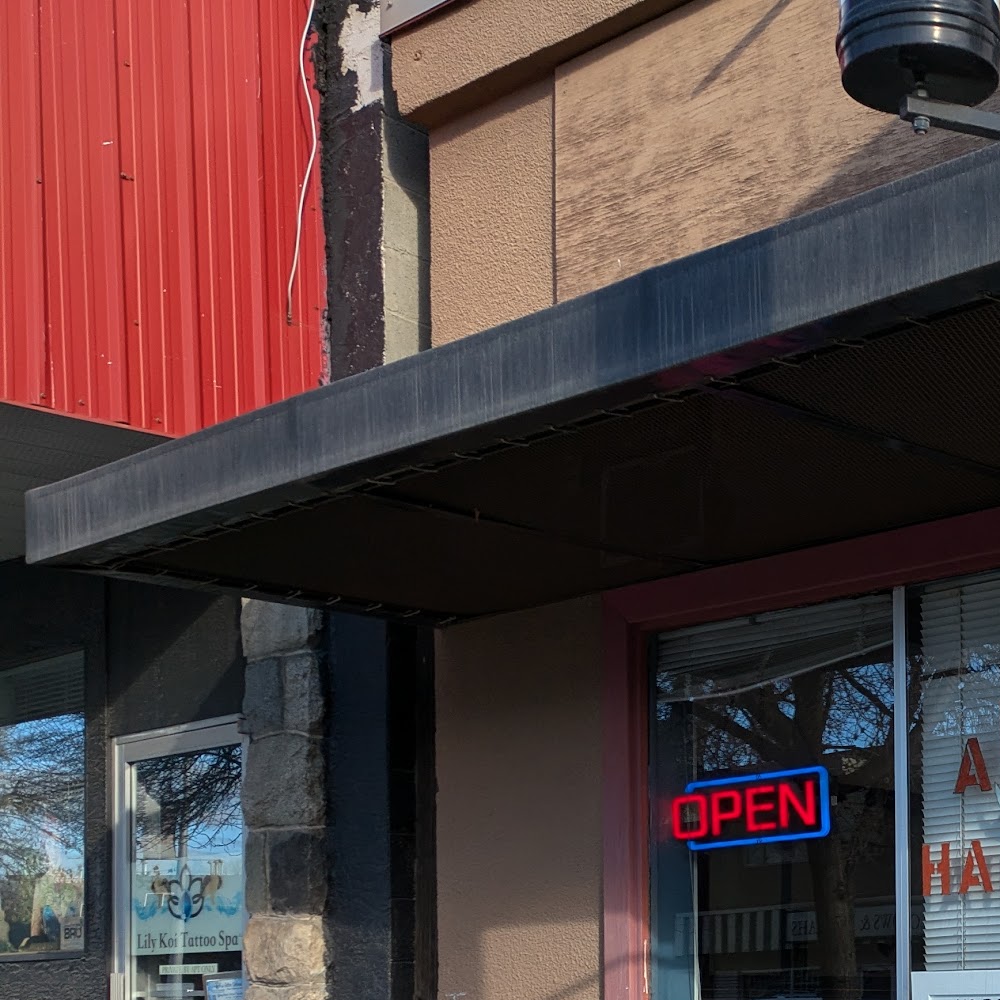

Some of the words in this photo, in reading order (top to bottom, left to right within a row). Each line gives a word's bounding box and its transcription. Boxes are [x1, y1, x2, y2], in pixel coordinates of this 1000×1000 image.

[671, 779, 817, 841] OPEN
[137, 933, 156, 952] Lily
[159, 932, 178, 949] Koi
[181, 931, 216, 948] Tattoo
[218, 930, 239, 950] Spa
